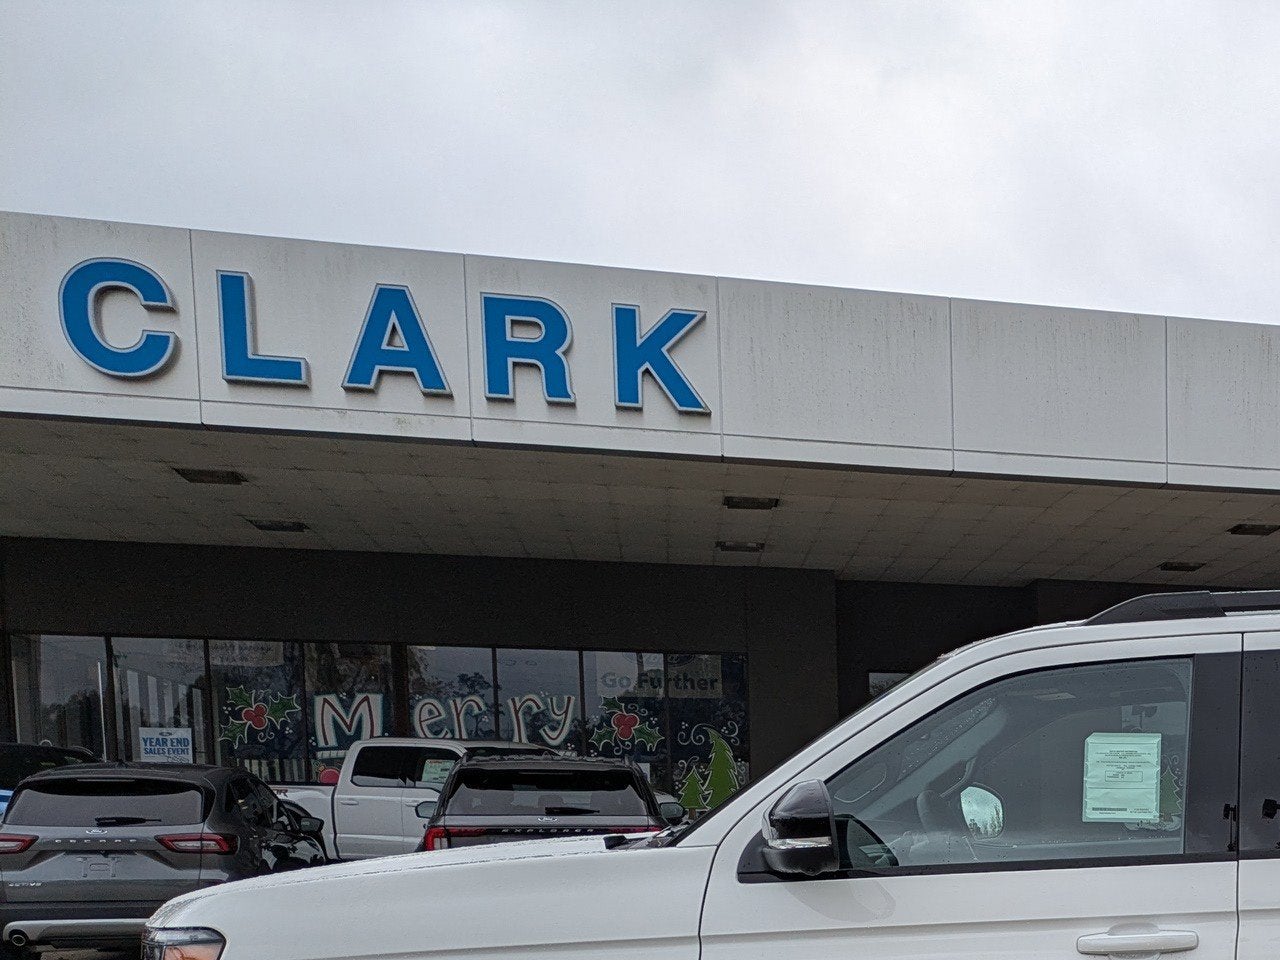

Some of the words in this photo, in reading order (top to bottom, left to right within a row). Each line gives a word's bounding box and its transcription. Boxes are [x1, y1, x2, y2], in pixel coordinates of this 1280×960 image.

[59, 257, 711, 415] CLARK
[601, 671, 632, 689] Go
[313, 691, 578, 748] Merry
[142, 737, 169, 747] YEAR
[170, 738, 190, 747] END
[144, 747, 166, 755] SALES
[167, 748, 189, 756] EVENT
